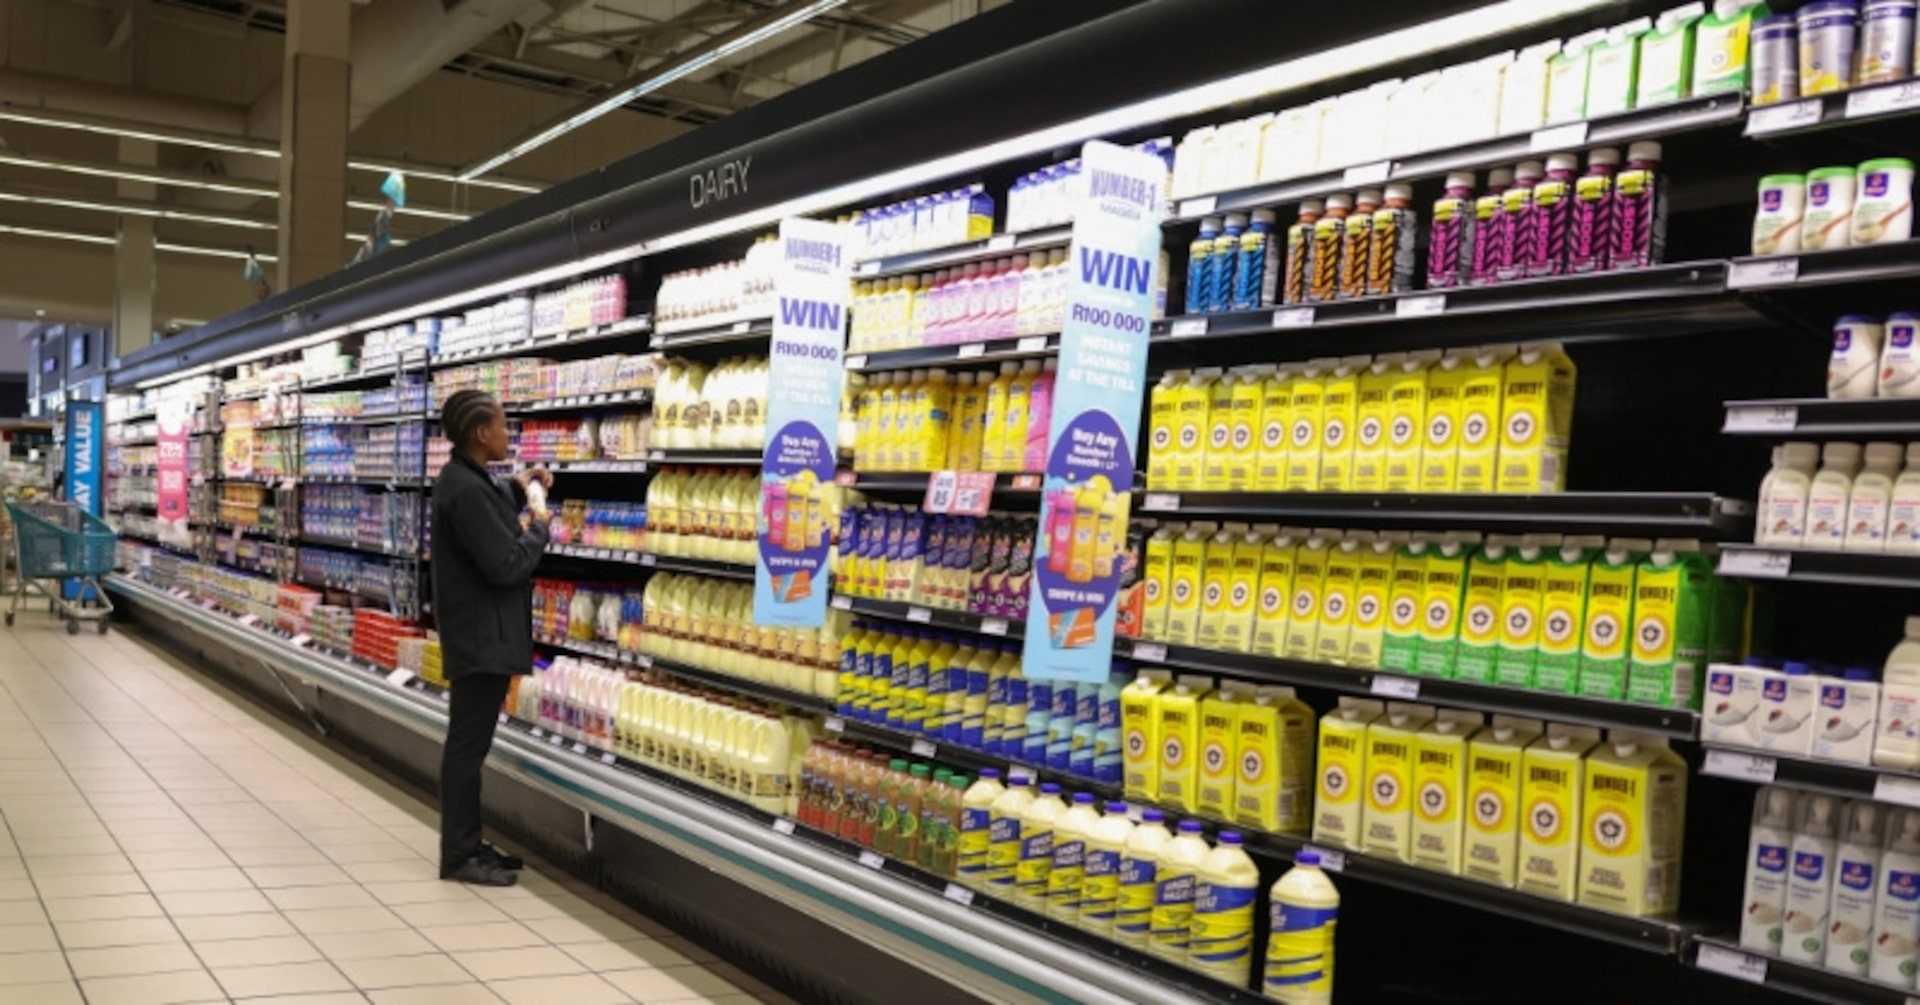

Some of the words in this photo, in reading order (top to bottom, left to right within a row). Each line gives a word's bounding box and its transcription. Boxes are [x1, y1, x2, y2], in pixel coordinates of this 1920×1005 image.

[690, 156, 752, 209] DAIRY
[1080, 247, 1150, 295] WIN
[780, 297, 841, 331] WIN
[1072, 303, 1111, 328] R100
[1113, 312, 1146, 333] 000
[776, 341, 808, 356] R100
[810, 345, 838, 360] 000
[74, 410, 93, 474] VALUE
